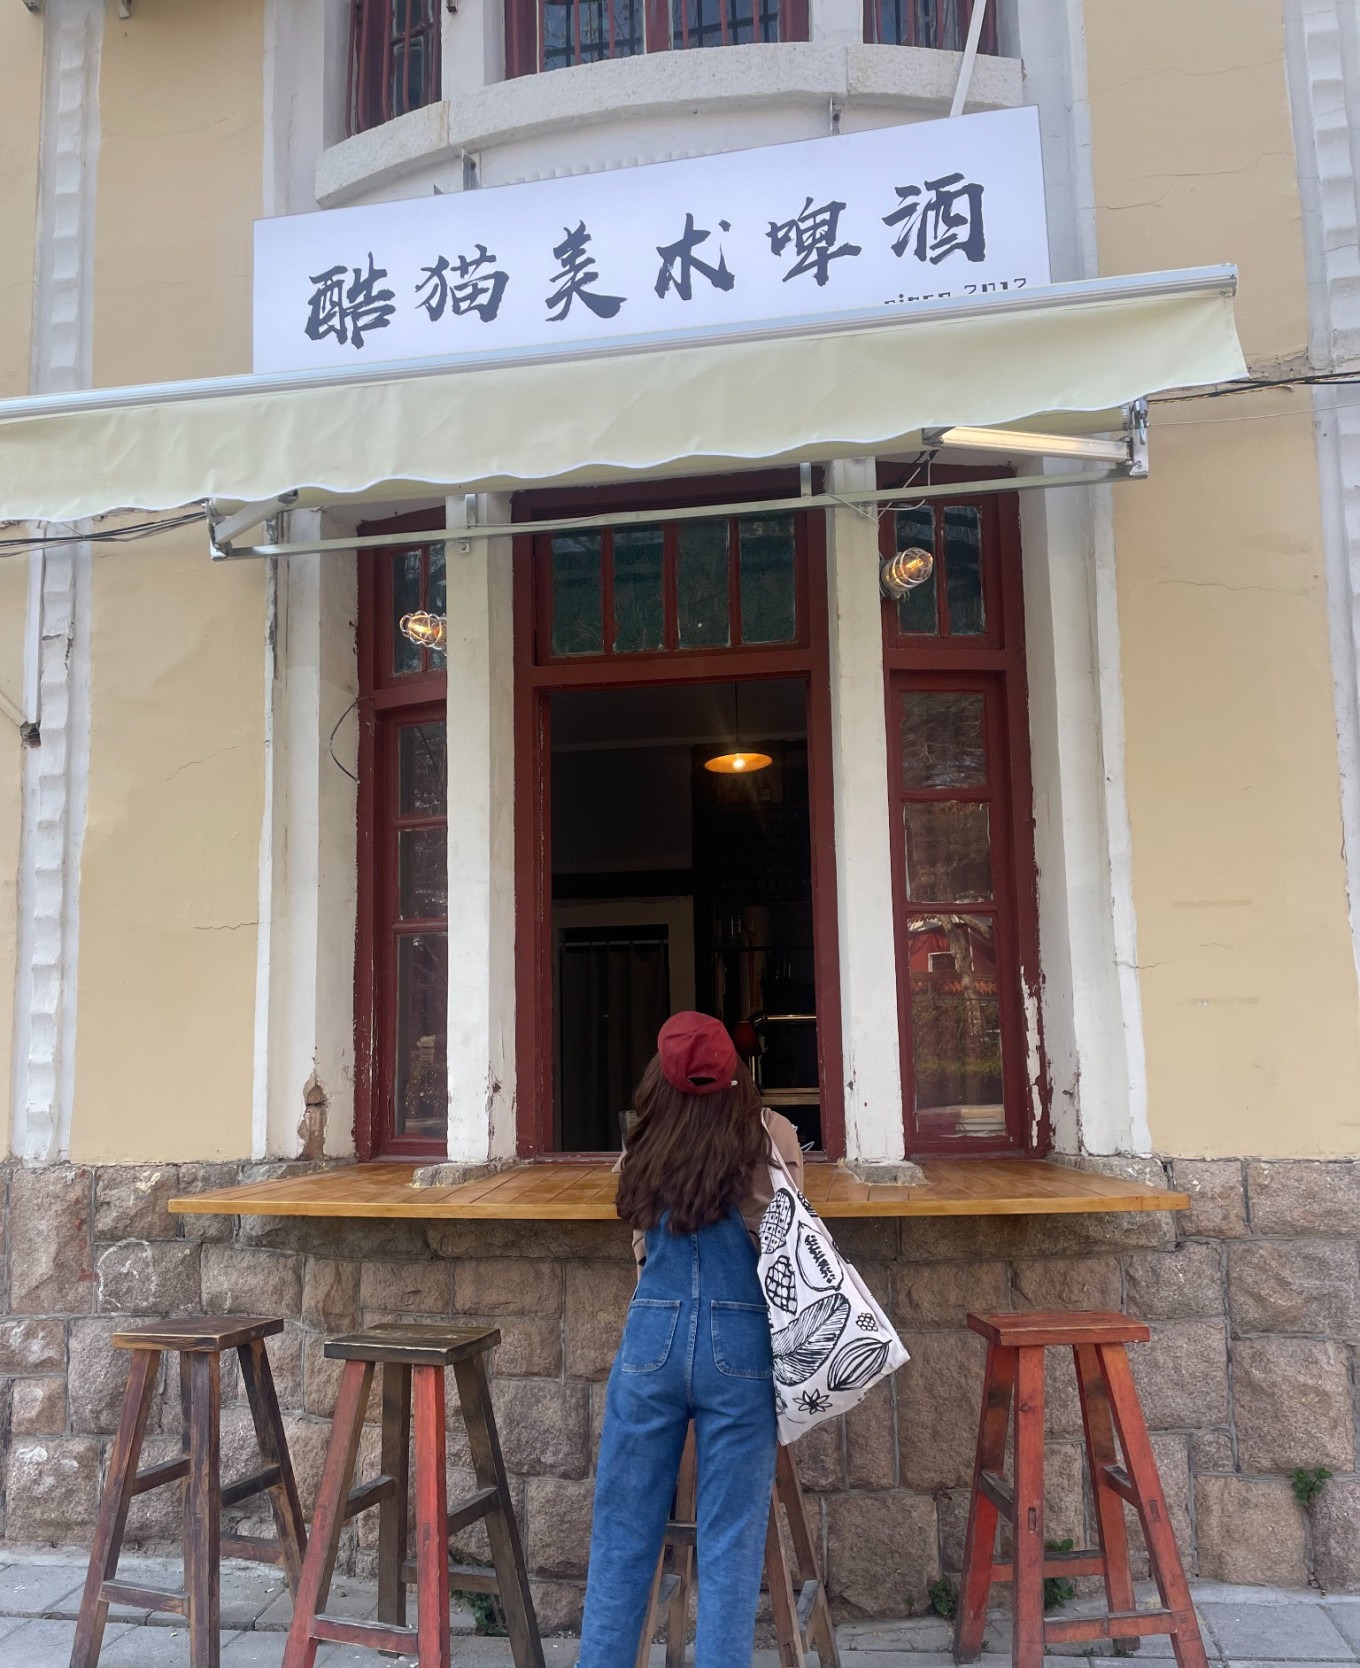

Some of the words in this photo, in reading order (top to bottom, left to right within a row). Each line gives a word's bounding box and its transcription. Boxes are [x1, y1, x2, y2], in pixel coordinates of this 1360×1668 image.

[304, 173, 986, 349] 酷猫美术啤酒
